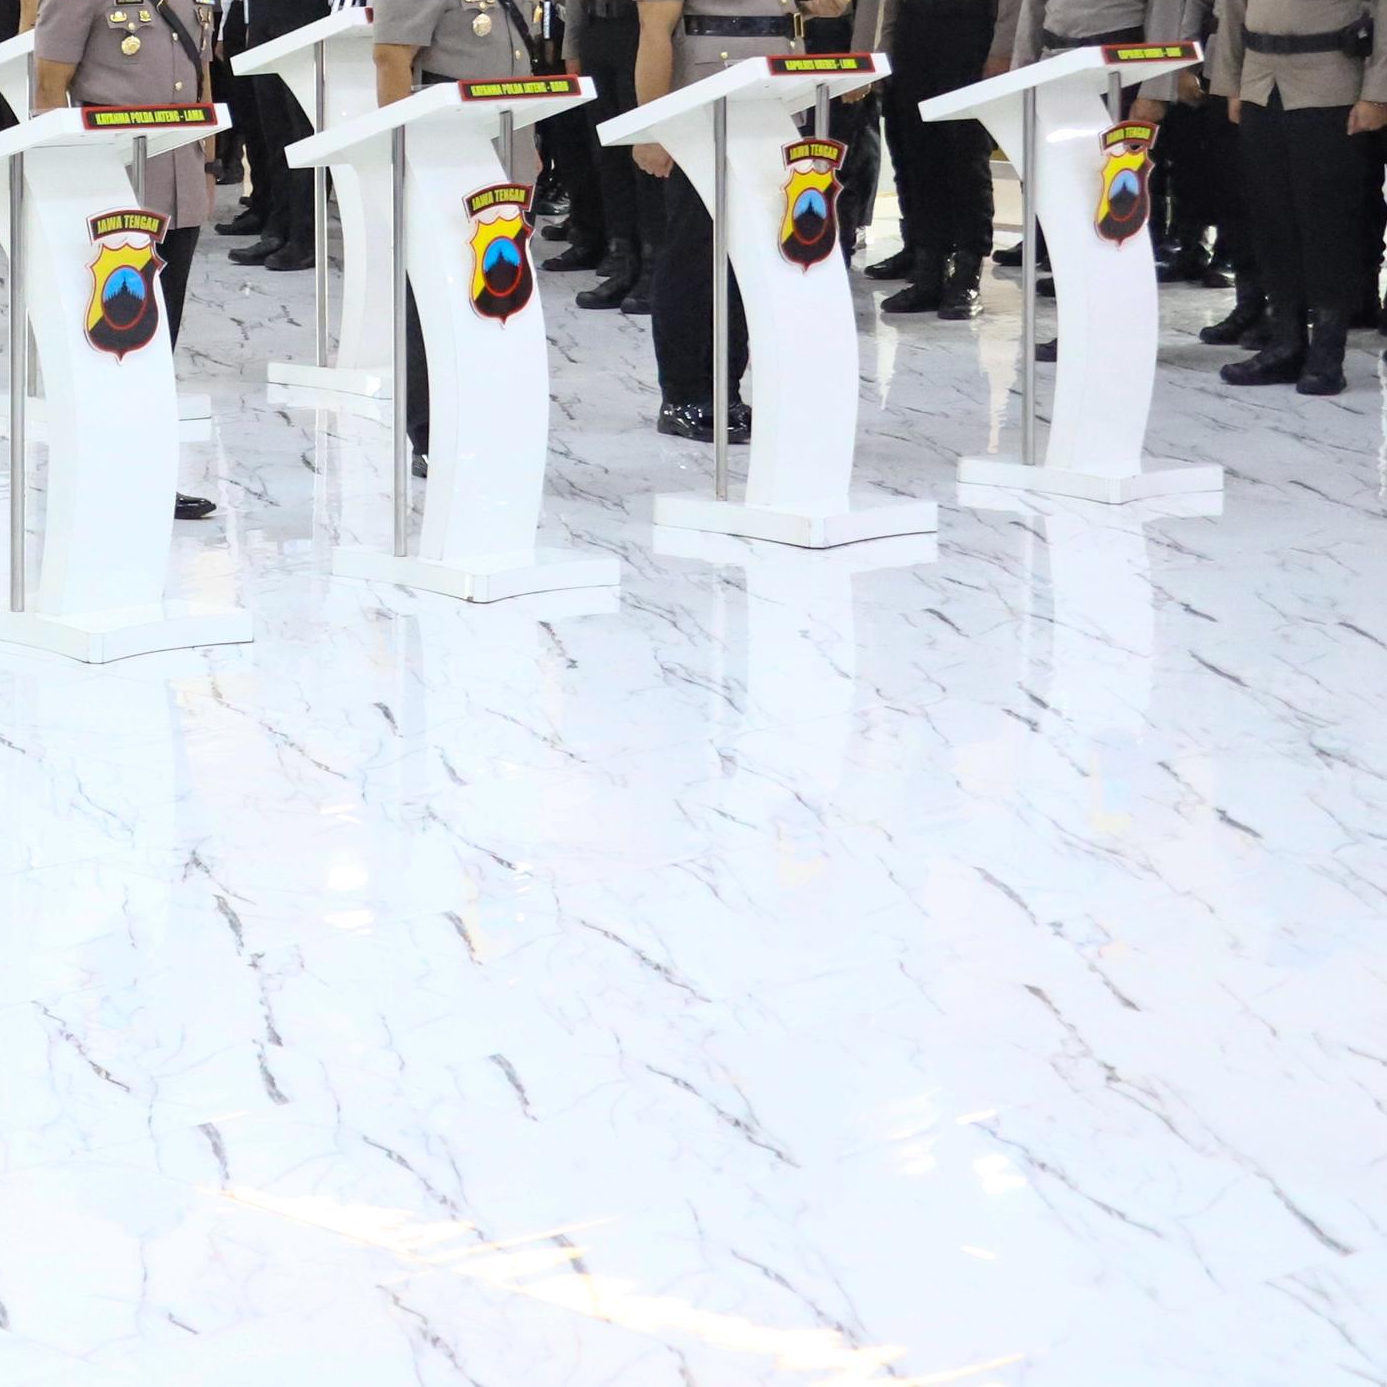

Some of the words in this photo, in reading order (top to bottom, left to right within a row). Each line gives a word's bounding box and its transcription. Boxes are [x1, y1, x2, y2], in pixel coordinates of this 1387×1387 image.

[130, 112, 154, 124] POLDA
[154, 110, 180, 123] JATENG
[184, 110, 205, 121] LAMA
[472, 192, 494, 211] JAWA
[494, 188, 526, 202] TENGAH
[97, 218, 122, 234] JAWA
[124, 215, 160, 232] TENGAH
